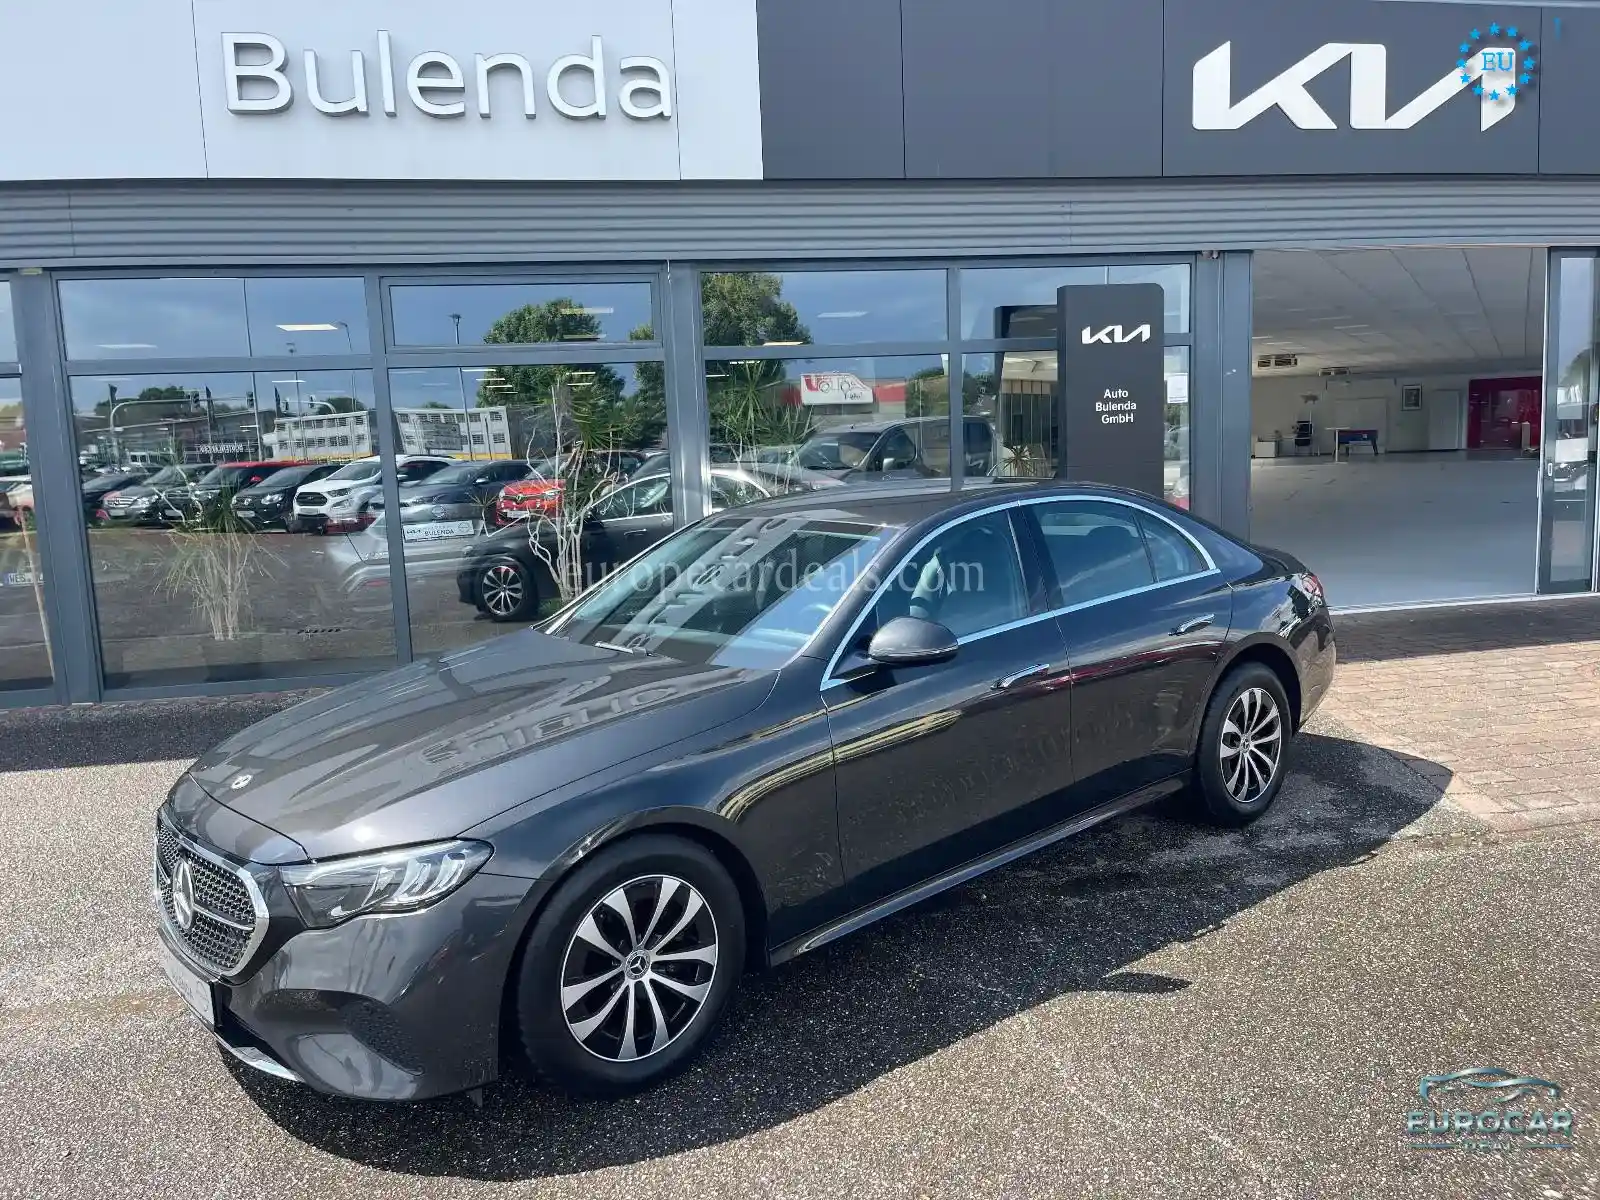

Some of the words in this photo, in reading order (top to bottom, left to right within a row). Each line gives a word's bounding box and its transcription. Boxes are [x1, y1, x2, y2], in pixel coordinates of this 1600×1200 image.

[221, 29, 672, 121] Bulenda
[1192, 40, 1516, 132] KIA
[1081, 324, 1151, 344] KIA
[1103, 388, 1129, 399] Auto
[1095, 400, 1137, 412] Bulenda
[1101, 413, 1134, 424] GmbH
[424, 528, 455, 536] BULENDA
